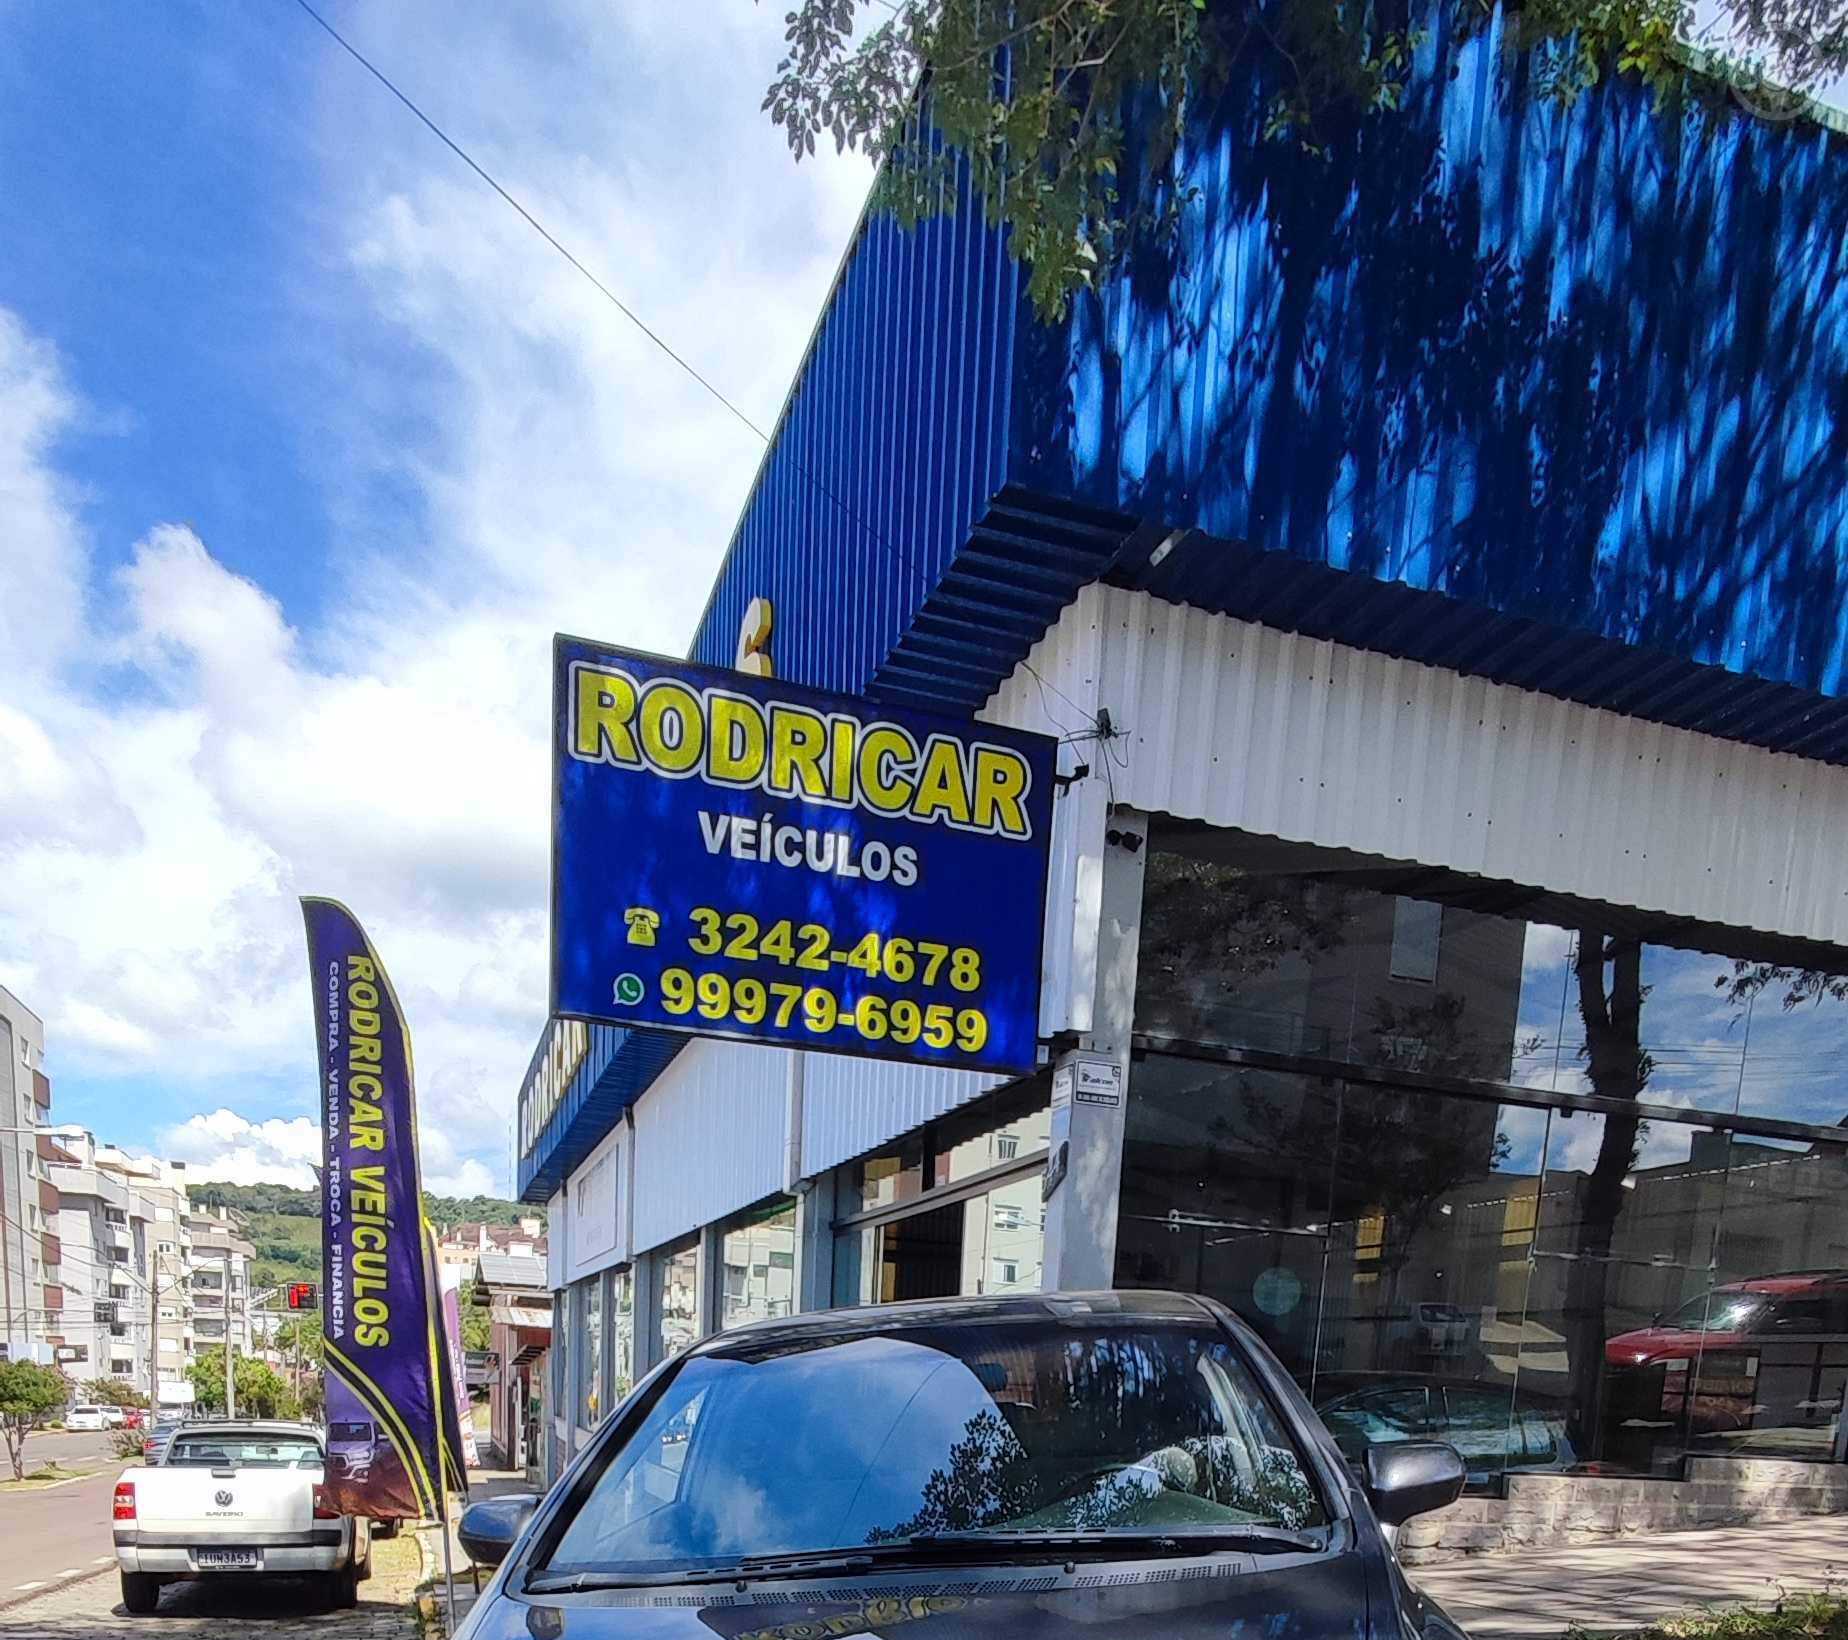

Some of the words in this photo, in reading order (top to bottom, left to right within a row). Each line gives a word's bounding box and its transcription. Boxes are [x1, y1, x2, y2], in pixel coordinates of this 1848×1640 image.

[568, 660, 1032, 841] RODRICAR
[698, 810, 919, 886] VEÍCULOS
[688, 908, 981, 992] 3242-4678
[328, 961, 339, 1052] COMPRA
[660, 968, 988, 1053] 99979-6959
[348, 955, 385, 1151] RODRICAR
[328, 1069, 340, 1140] VENDA
[329, 1157, 341, 1227] TROCA
[331, 1244, 345, 1340] FINANCIA
[350, 1165, 394, 1348] VEÍCULOS
